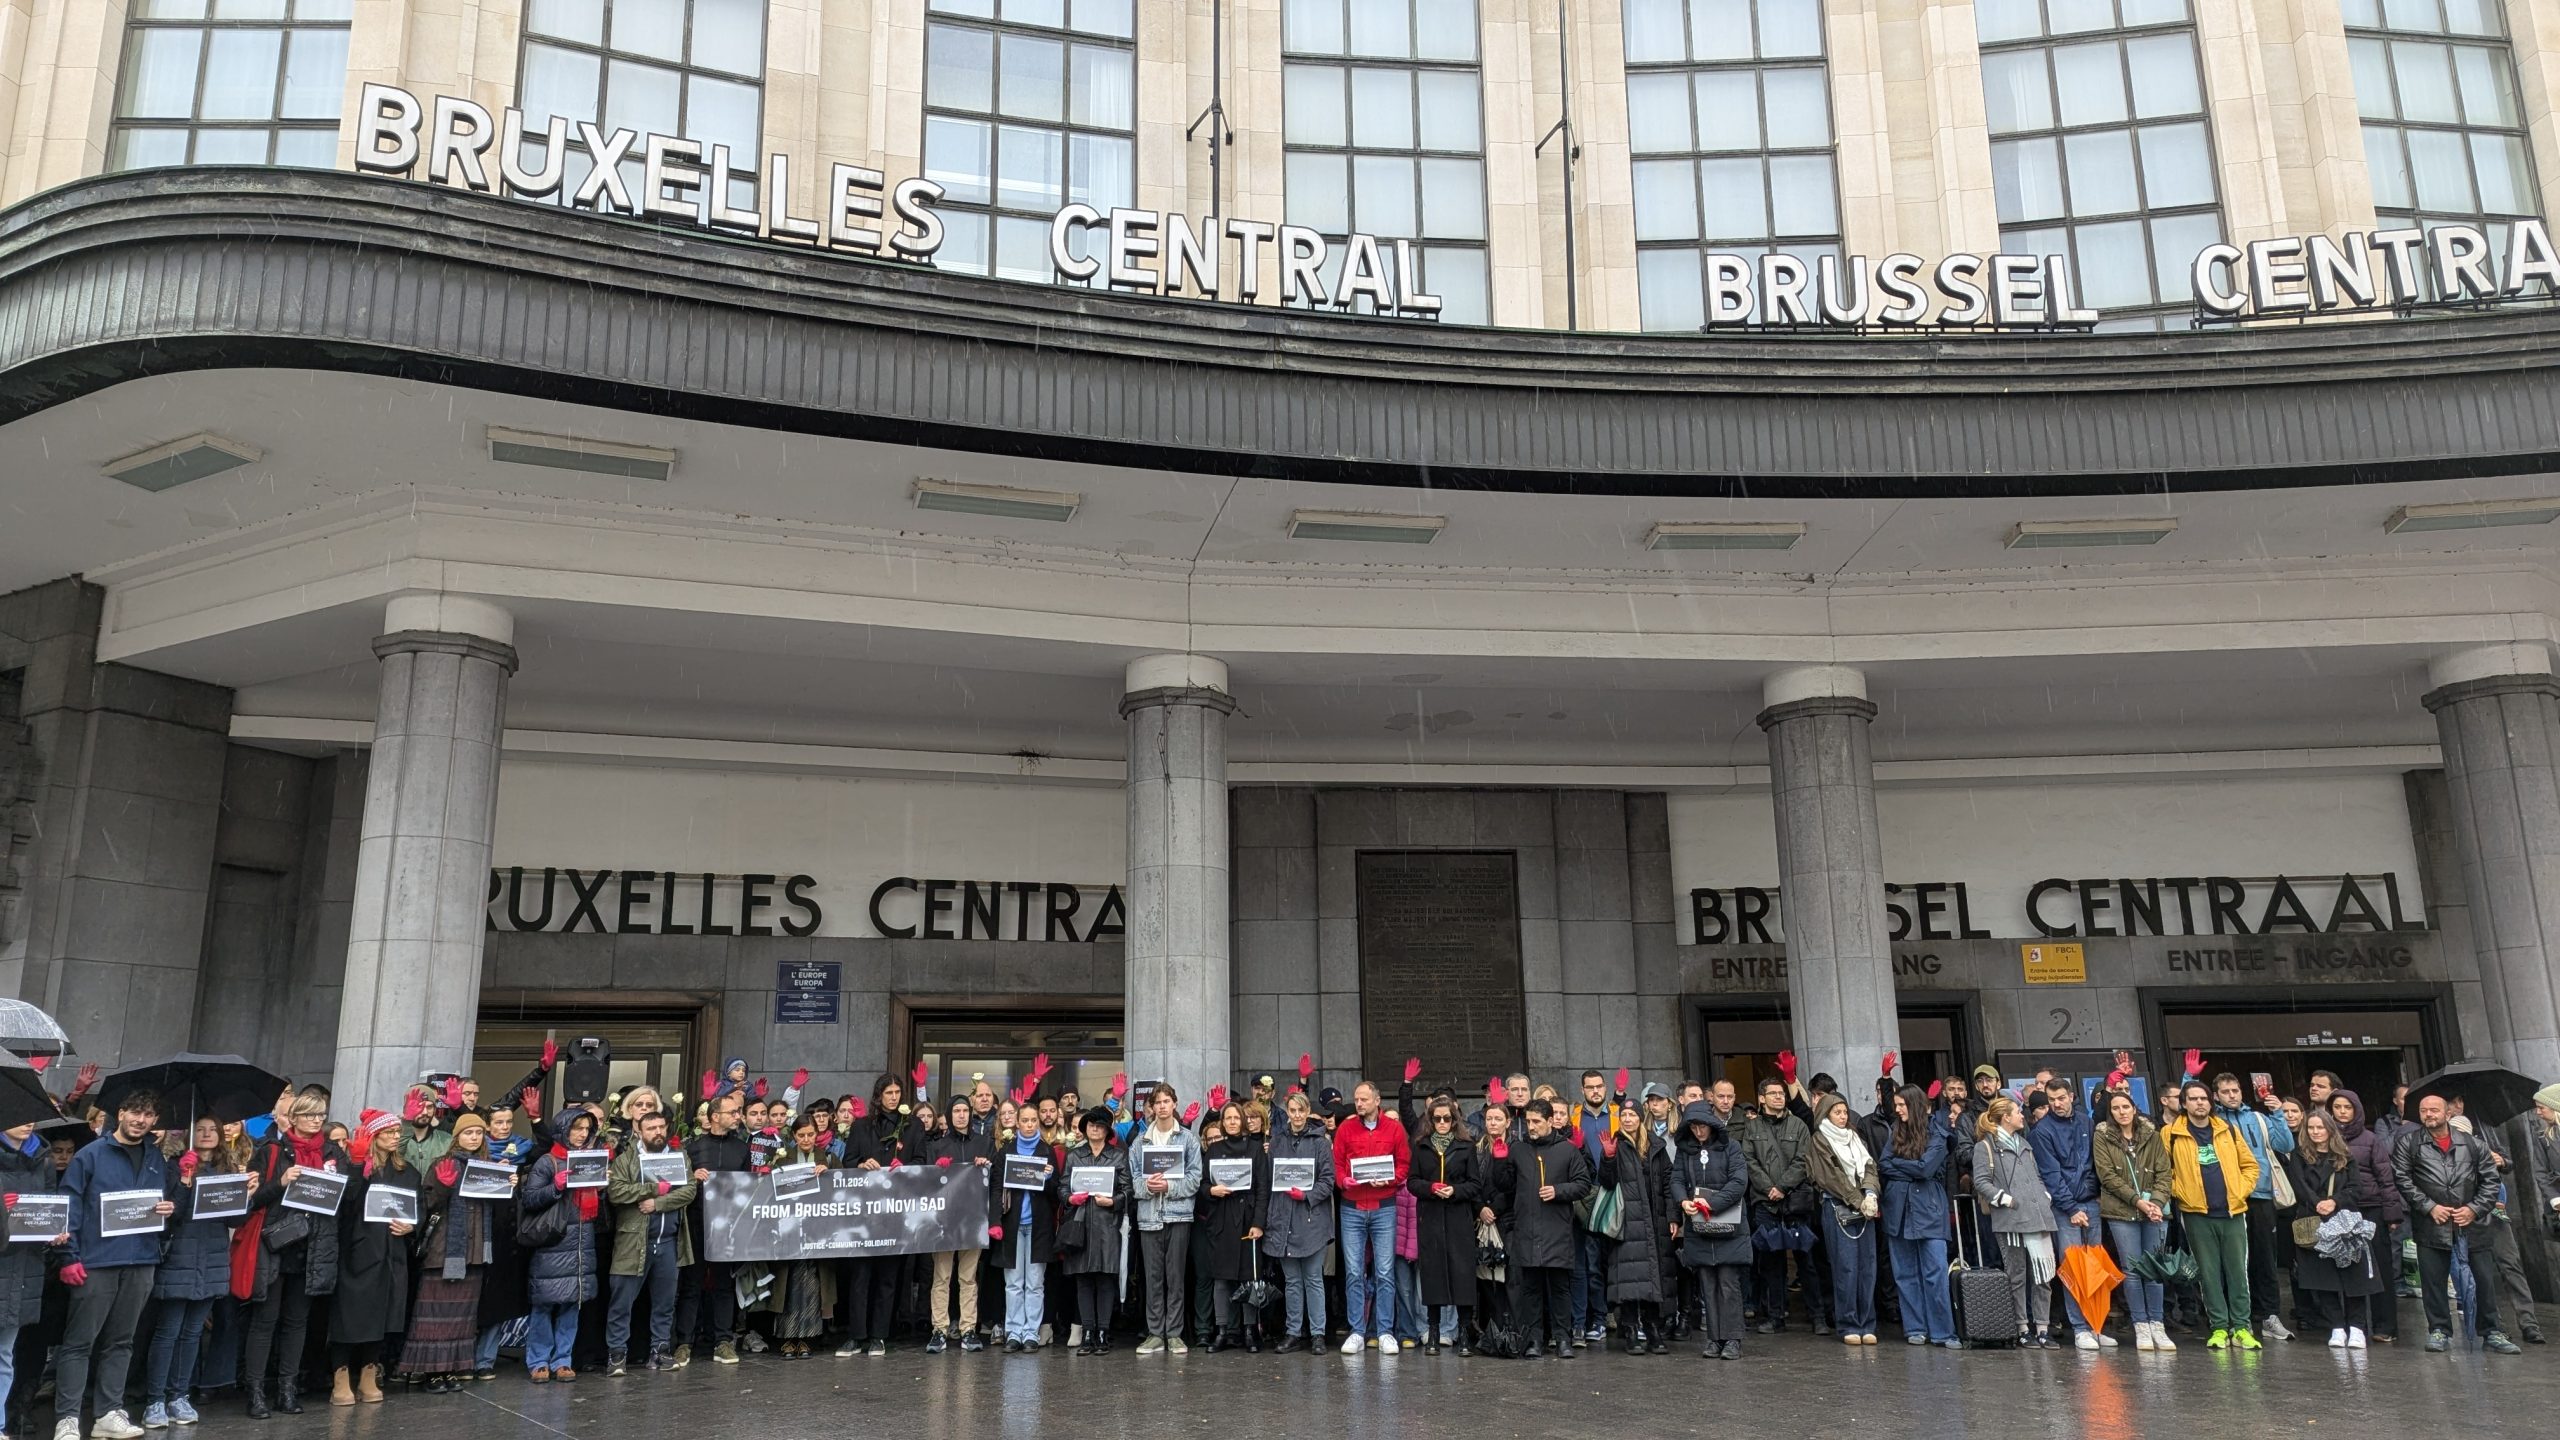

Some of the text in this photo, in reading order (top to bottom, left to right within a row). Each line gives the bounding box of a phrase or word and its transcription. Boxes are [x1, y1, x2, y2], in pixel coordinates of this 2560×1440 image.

[356, 82, 1442, 316] BRUXELLES CENTRAL
[1705, 219, 2560, 331] BRUSSEL CENTRA
[2026, 872, 2425, 938] CENTRAAL
[2167, 949, 2266, 972] ENTREE
[2296, 946, 2412, 970] INGANG
[794, 979, 824, 987] EUROPA
[2049, 1007, 2074, 1044] 2
[833, 1177, 869, 1188] 1.11.2024
[752, 1196, 946, 1219] FROM BRUSSELS TO NOVI SAD
